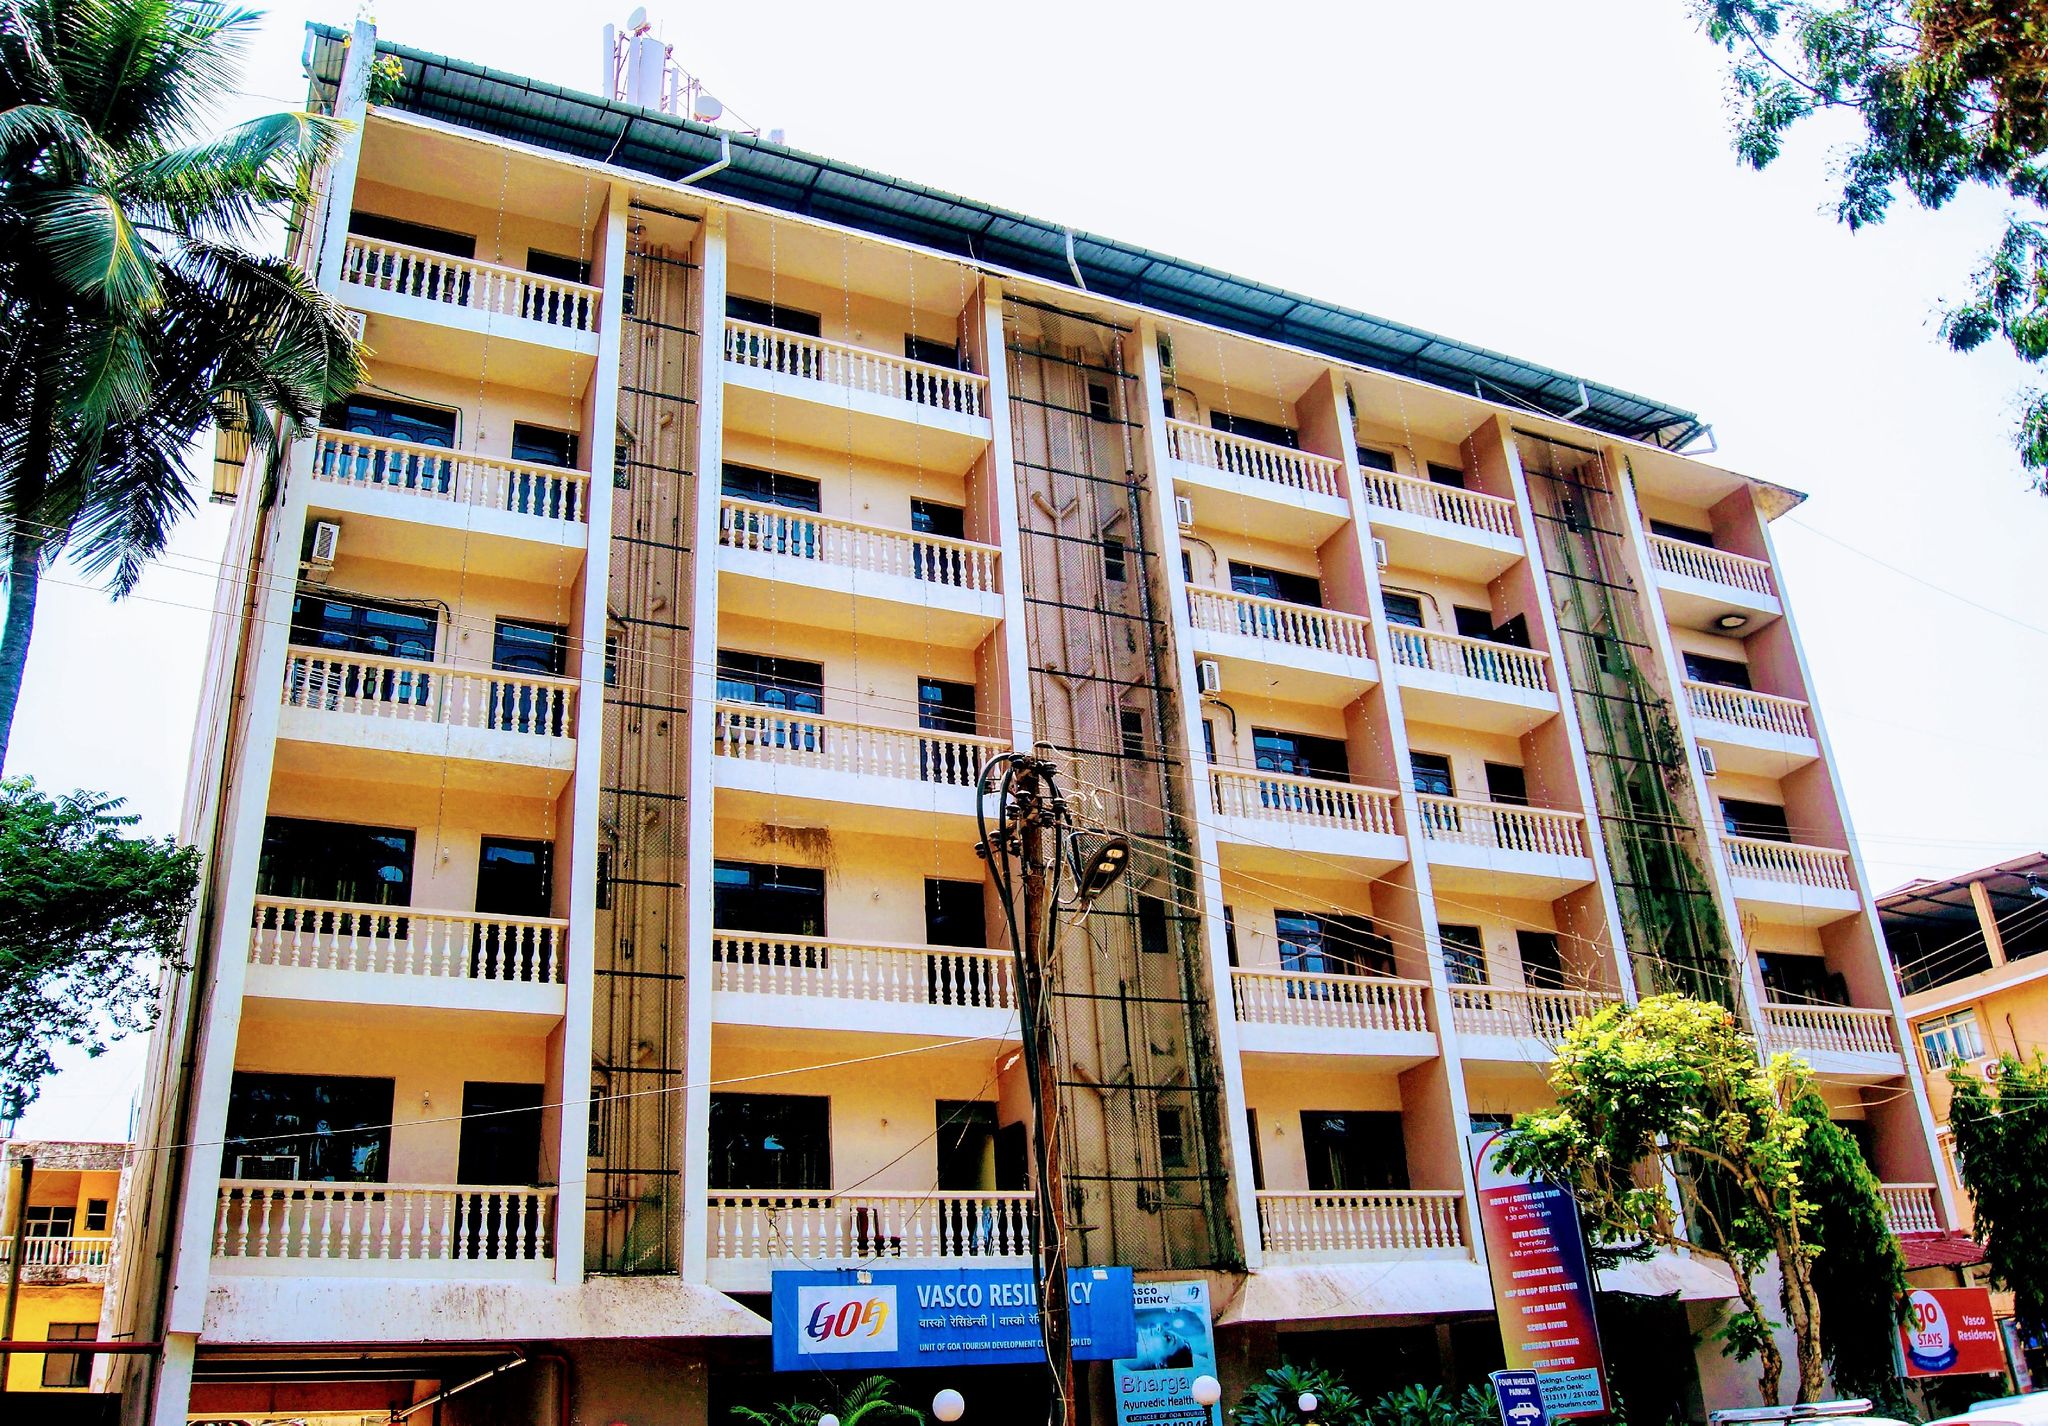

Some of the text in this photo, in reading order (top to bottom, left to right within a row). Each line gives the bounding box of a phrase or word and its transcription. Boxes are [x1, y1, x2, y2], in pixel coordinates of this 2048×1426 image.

[1490, 1196, 1509, 1206] NORTH
[1513, 1193, 1532, 1203] SOUTH
[1532, 1190, 1545, 1199] GOA
[1545, 1189, 1560, 1198] TOUR
[1523, 1201, 1545, 1210] Vasco)
[1541, 1210, 1552, 1218] pm
[1529, 1227, 1551, 1237] CRUISE
[1519, 1238, 1547, 1248] Everyday
[1547, 1265, 1563, 1274] TOUR
[1561, 1281, 1578, 1291] TOUR
[917, 1282, 1093, 1308] VASCO RESICY
[804, 1297, 890, 1342] GOA
[919, 1314, 946, 1328] वास्को
[999, 1312, 1025, 1326] वास्को
[1962, 1315, 1986, 1326] Vasco
[1917, 1332, 1943, 1345] STAYS
[1957, 1328, 1996, 1342] Residency
[919, 1343, 936, 1351] UNIT
[937, 1343, 946, 1351] OF
[947, 1342, 961, 1350] GOA
[962, 1341, 991, 1350] TOURISM
[992, 1339, 1037, 1349] DEVELOPMENT
[1080, 1337, 1092, 1346] LTD
[1498, 1377, 1536, 1387] FOUR WHEELER
[1565, 1373, 1592, 1382] Contact
[1508, 1387, 1531, 1396] PARKING
[1123, 1396, 1195, 1412] Ayurvedic Health
